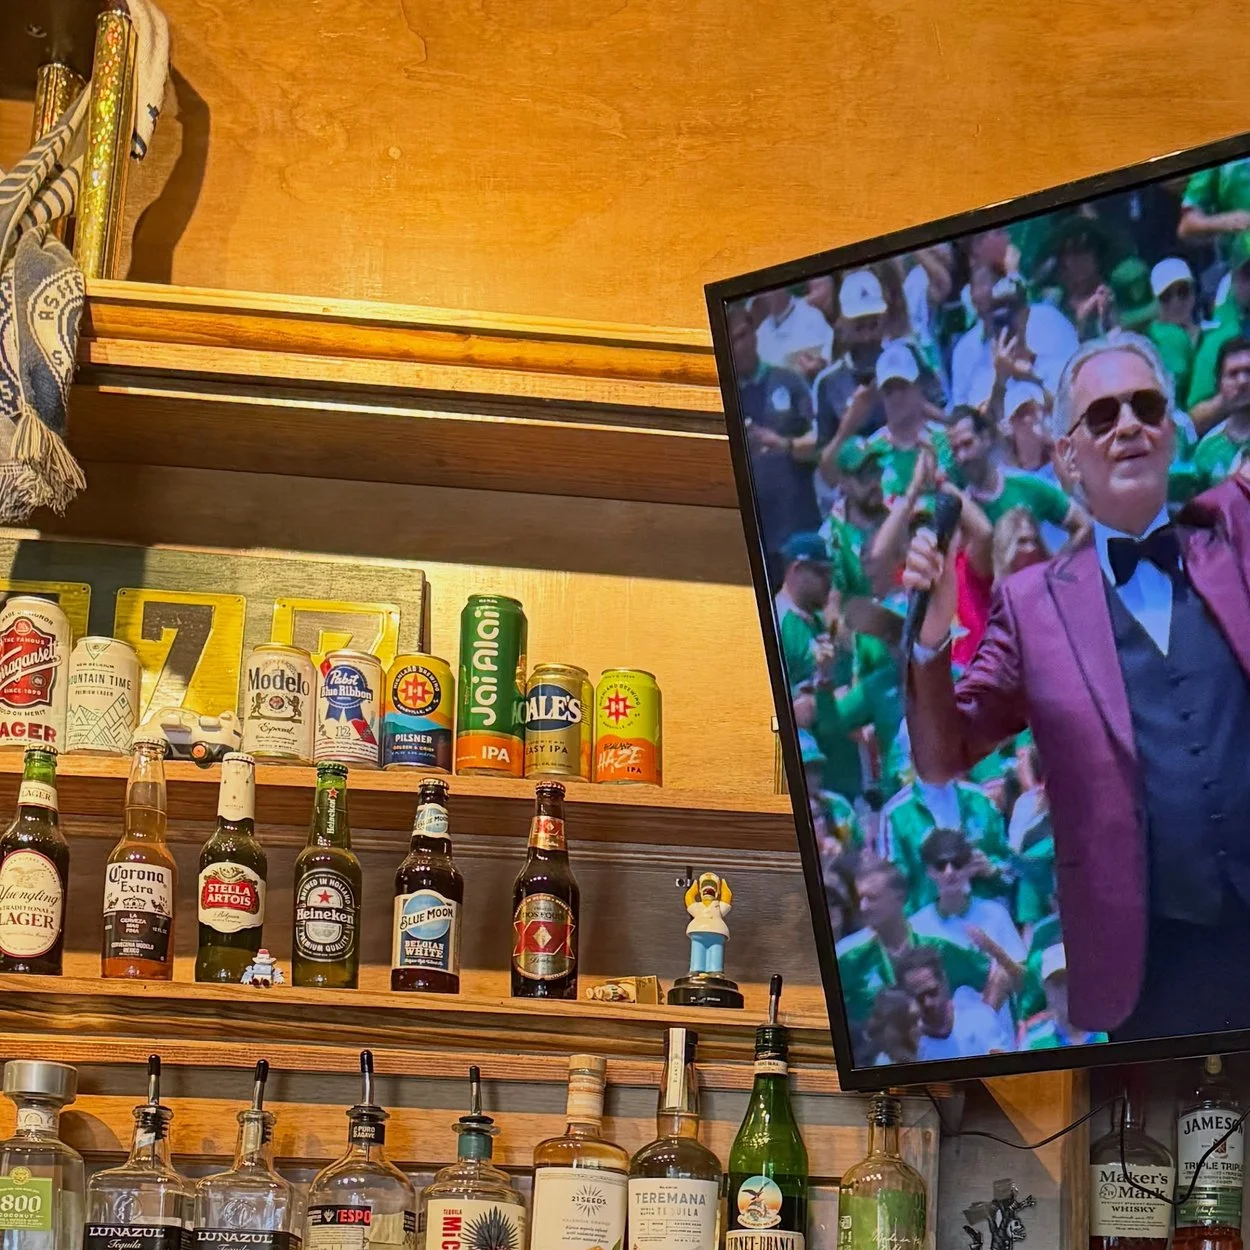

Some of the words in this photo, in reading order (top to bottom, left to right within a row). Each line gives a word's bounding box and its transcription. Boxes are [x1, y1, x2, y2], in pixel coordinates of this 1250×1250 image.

[16, 636, 45, 645] FAMOUS
[472, 607, 500, 671] Alai
[109, 675, 132, 691] TIME
[248, 667, 310, 696] Modelo
[330, 669, 360, 686] Pabst
[393, 666, 417, 689] HIGHLAND
[418, 667, 440, 692] BREWING
[321, 685, 338, 698] Blue
[338, 685, 372, 701] Ribbon
[619, 683, 641, 706] BREWING
[471, 676, 499, 726] Jai
[24, 709, 46, 717] MERIT
[395, 733, 433, 744] PILSNER
[482, 745, 511, 764] IPA
[550, 744, 569, 755] IPA
[598, 745, 646, 773] HAZE
[627, 766, 642, 774] IPA
[21, 789, 52, 801] LAGER
[326, 798, 335, 835] Heineken
[109, 865, 164, 885] Corona
[120, 880, 154, 895] Extra
[208, 883, 251, 896] STELLA
[301, 878, 319, 901] BREWED
[318, 877, 328, 885] IN
[329, 878, 351, 905] HOLLAND
[0, 884, 59, 907] Yuengling
[207, 893, 251, 907] ARTOIS
[2, 905, 49, 915] TRADITIONAL
[296, 907, 354, 925] Heineken
[399, 912, 426, 931] BLUE
[426, 908, 454, 921] MOON
[299, 930, 324, 952] PREMIUM
[325, 936, 350, 952] QUALITY
[405, 940, 444, 950] BELGIAN
[404, 948, 444, 959] WHITE
[1099, 1170, 1169, 1185] Maker's
[635, 1192, 707, 1206] TEREMANA
[1117, 1186, 1166, 1200] Mark
[581, 1196, 607, 1206] SEEDS
[1111, 1205, 1156, 1213] WHISKY
[89, 1226, 166, 1239] LUNAZUL
[197, 1232, 274, 1244] LUNAZUL
